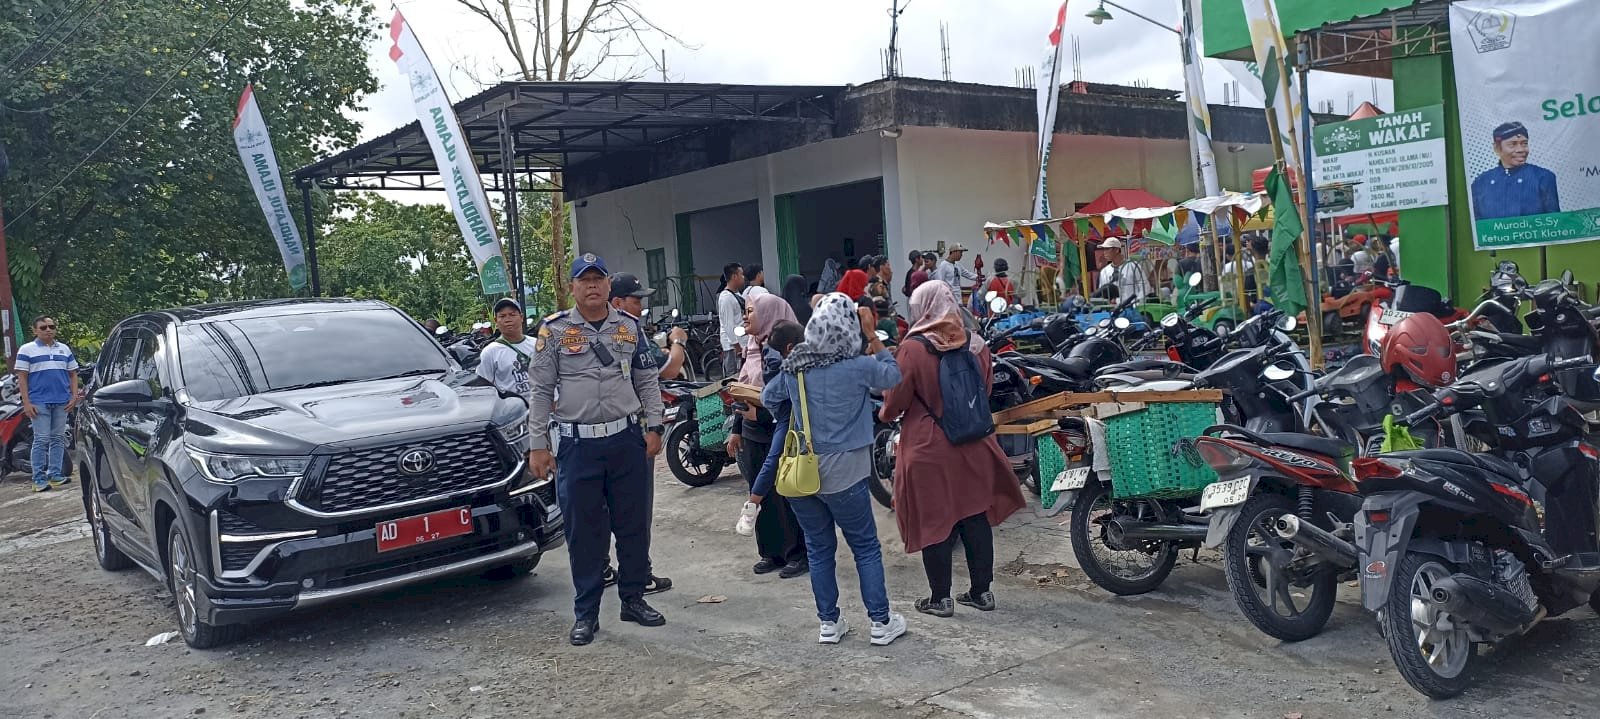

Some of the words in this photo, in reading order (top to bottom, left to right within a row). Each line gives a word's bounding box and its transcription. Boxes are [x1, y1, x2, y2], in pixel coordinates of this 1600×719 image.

[1376, 112, 1422, 128] TANAH
[1368, 122, 1432, 146] WAKAF
[1493, 221, 1532, 230] Murodi,
[1535, 217, 1559, 227] S.Sy
[1482, 234, 1510, 243] Ketua
[1513, 230, 1538, 240] FKDT
[1541, 228, 1576, 238] Klaten
[381, 522, 398, 542] AD
[424, 516, 429, 533] 1
[460, 509, 469, 525] C
